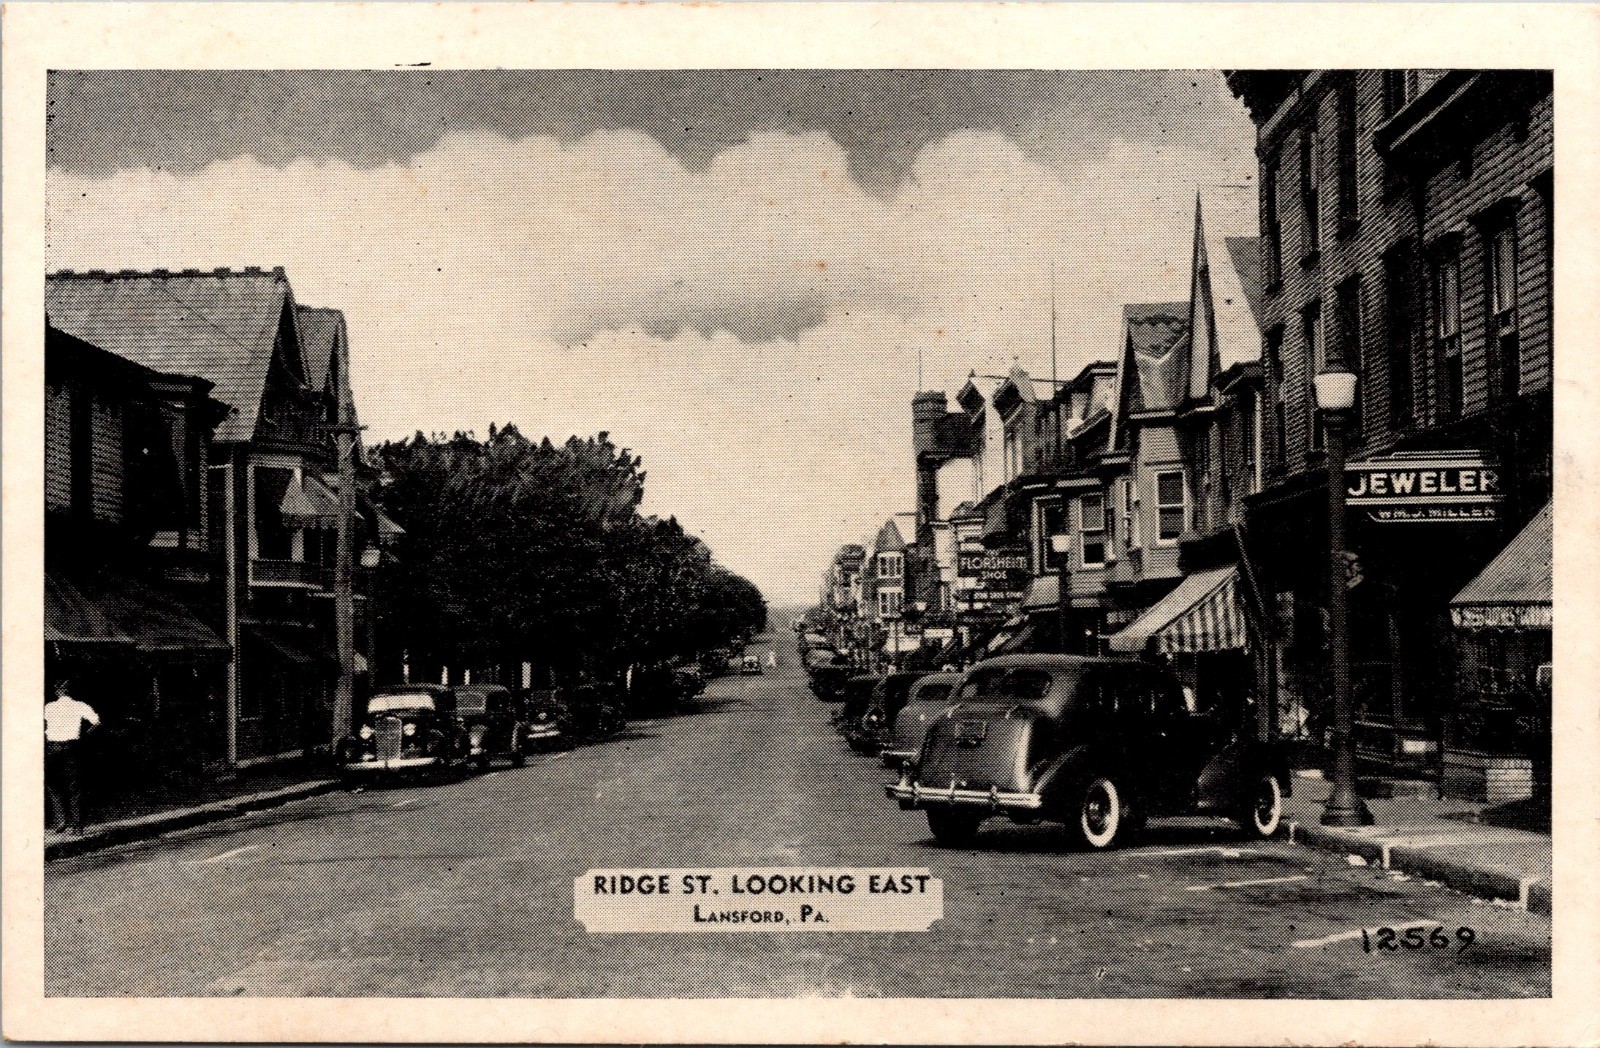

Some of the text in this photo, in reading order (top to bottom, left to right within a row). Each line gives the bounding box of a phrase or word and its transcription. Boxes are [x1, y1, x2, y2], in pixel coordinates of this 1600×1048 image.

[1348, 471, 1499, 496] JEWELER
[1428, 506, 1496, 518] MILLER
[960, 556, 1027, 570] FLORSHEIM
[981, 570, 1008, 580] SHOE
